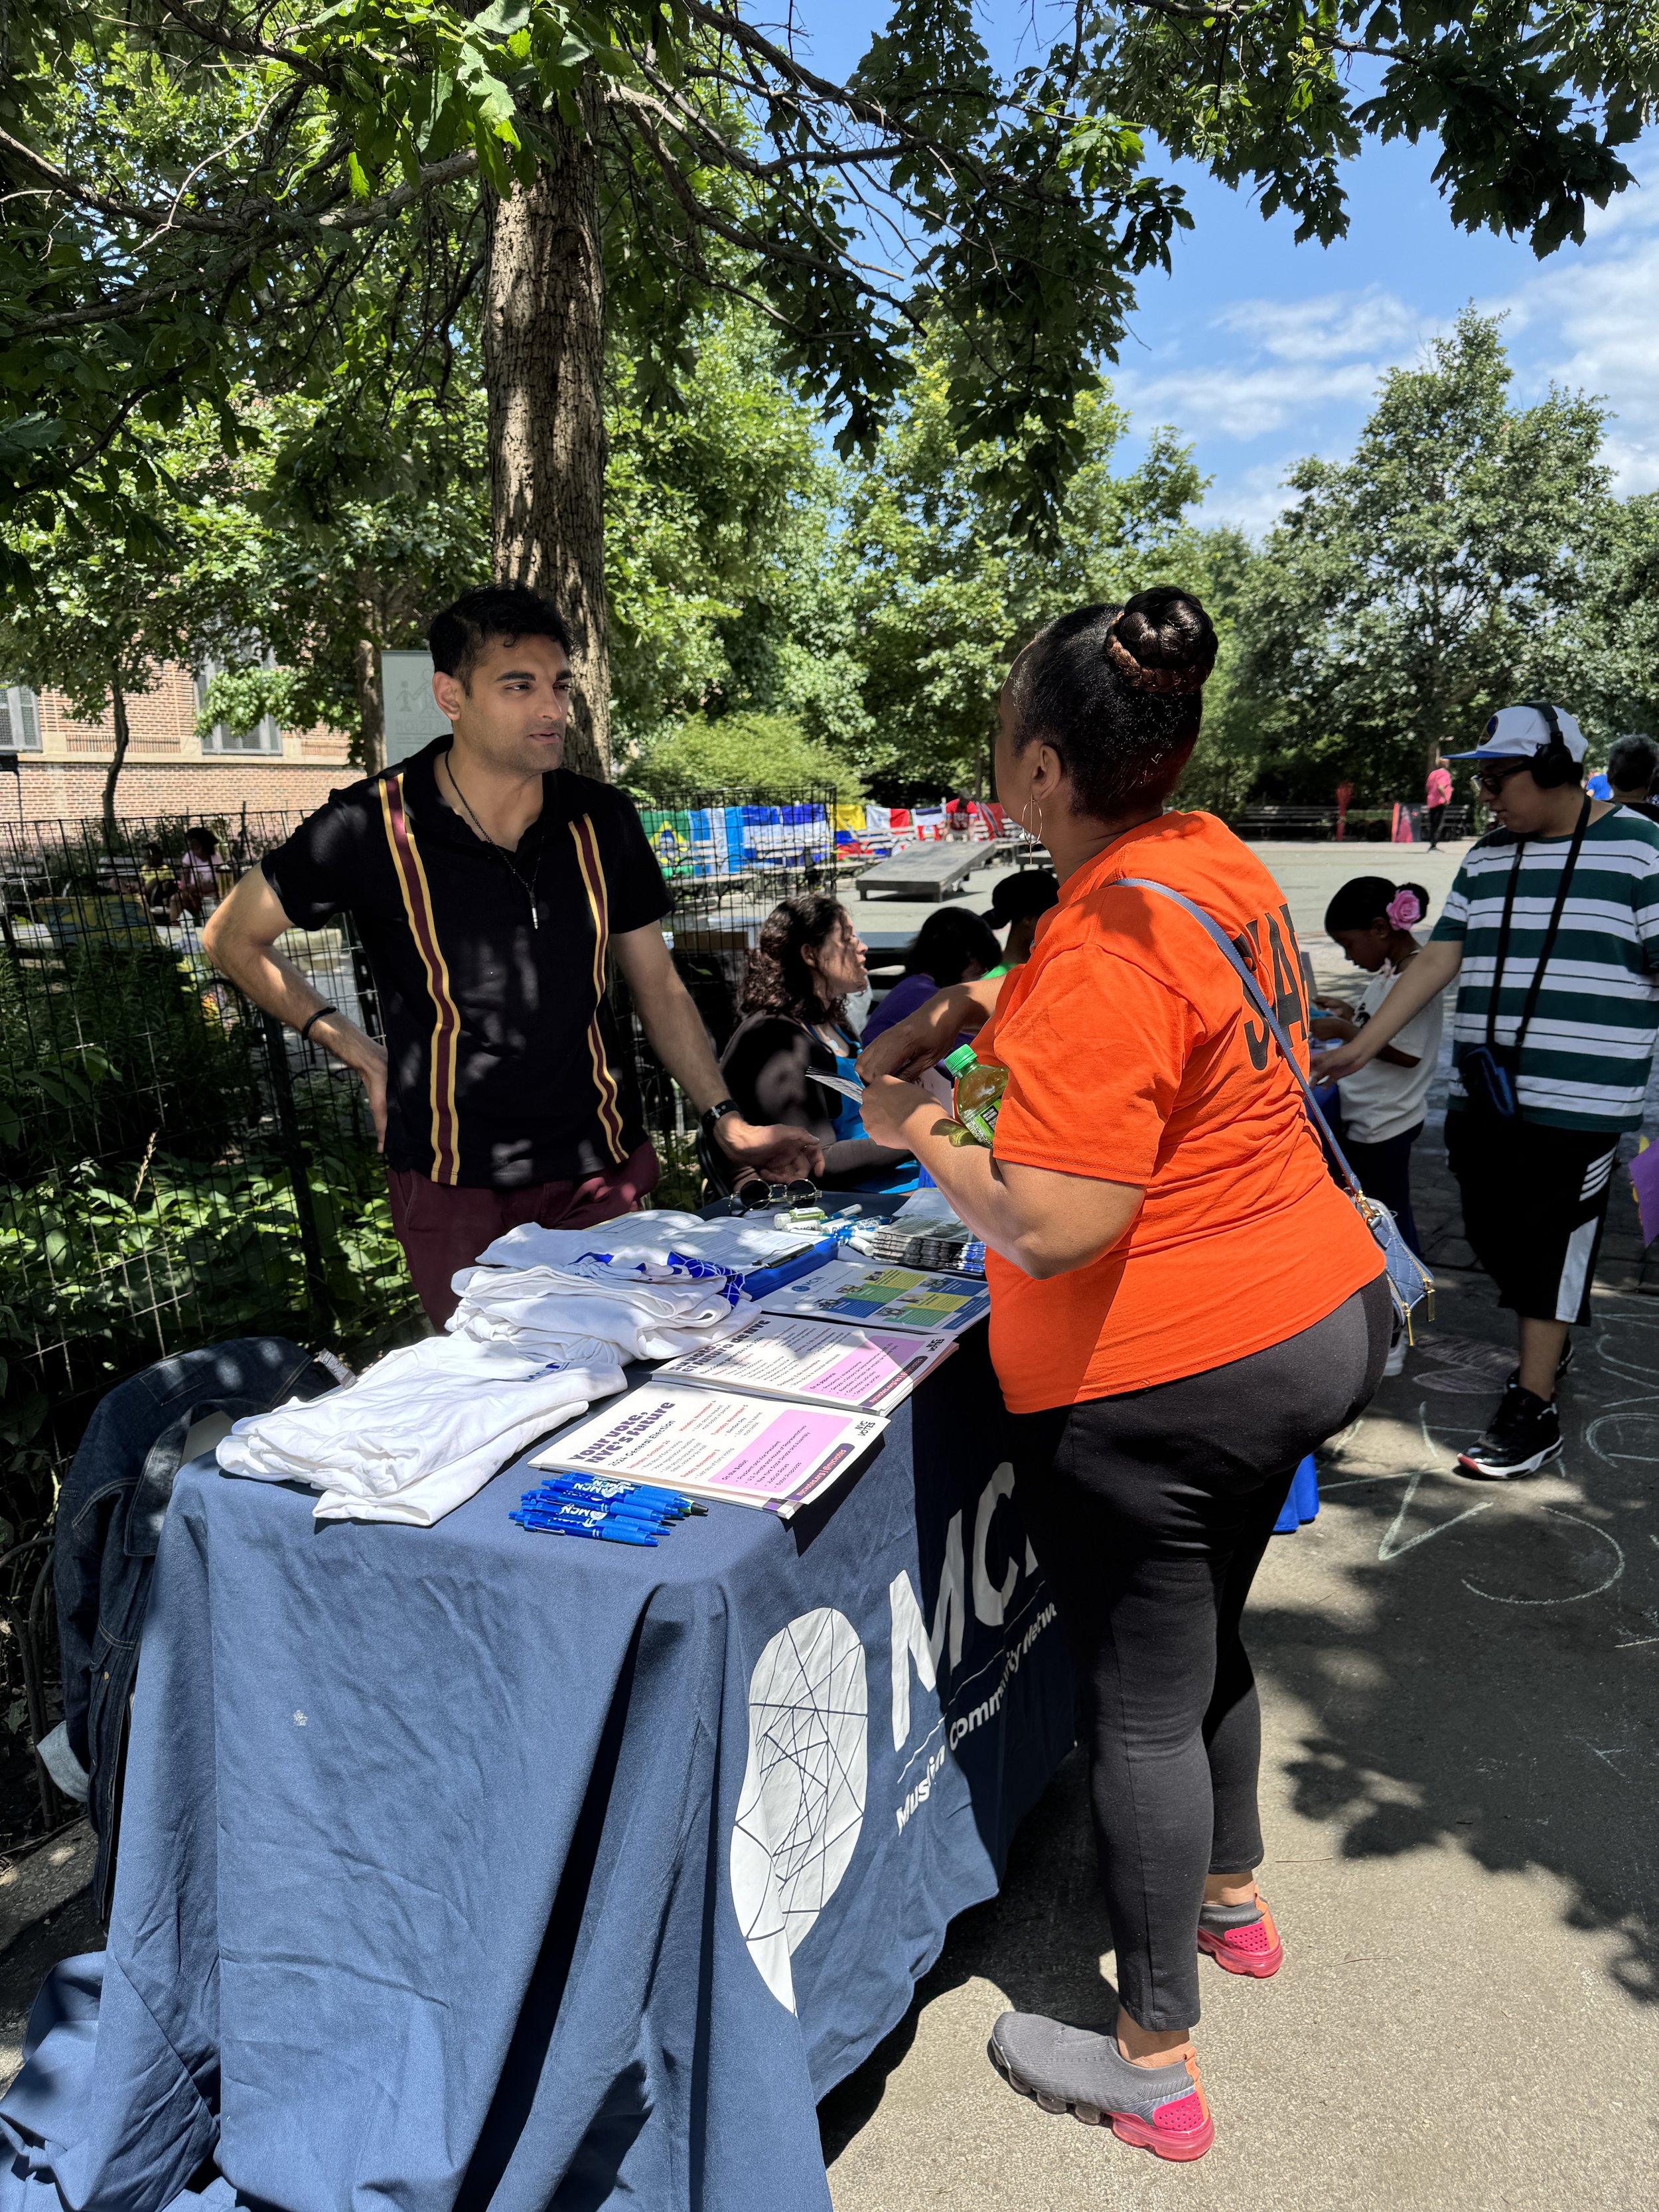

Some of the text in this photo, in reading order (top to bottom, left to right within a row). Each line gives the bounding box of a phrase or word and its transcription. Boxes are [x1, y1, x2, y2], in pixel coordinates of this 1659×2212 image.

[802, 1276, 825, 1286] MCN
[692, 1344, 733, 1365] futuro
[743, 1320, 770, 1333] NYC
[625, 1402, 674, 1435] future
[857, 1422, 876, 1436] VOTES
[568, 1411, 647, 1461] Your vote,
[608, 1420, 676, 1466] 2024 General Election
[573, 1482, 602, 1493] MCN
[796, 1449, 846, 1495] nycvotes.org @nycvotes
[562, 1505, 591, 1517] MCN
